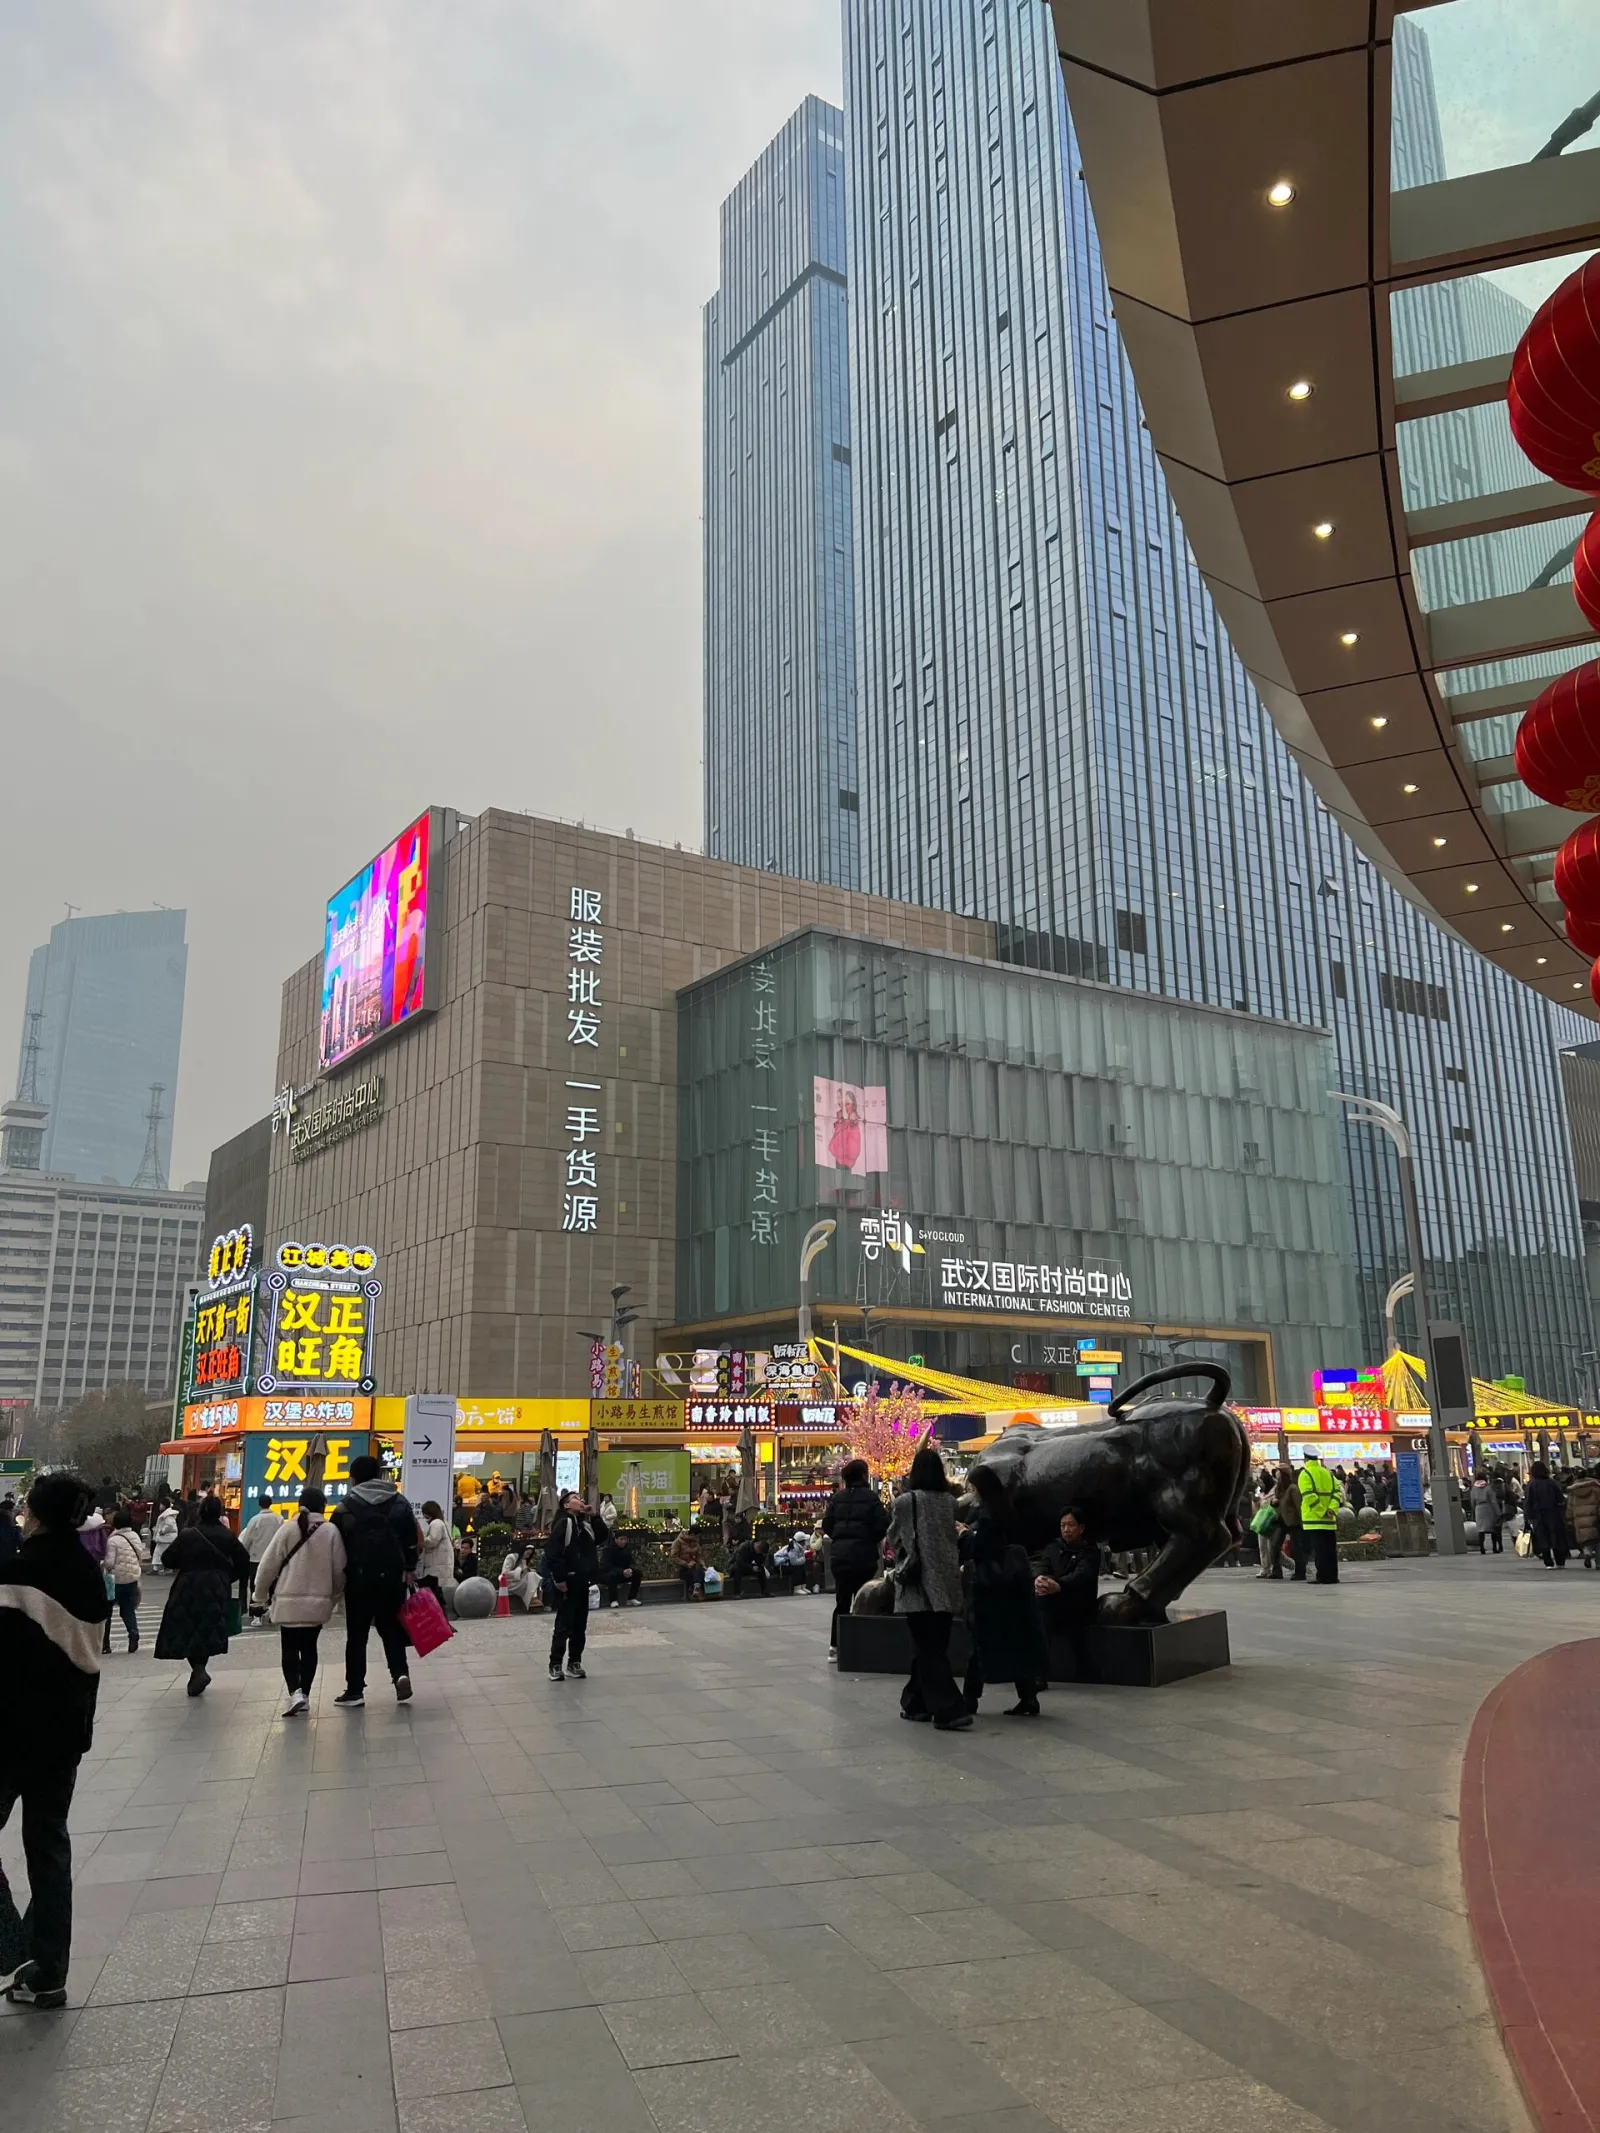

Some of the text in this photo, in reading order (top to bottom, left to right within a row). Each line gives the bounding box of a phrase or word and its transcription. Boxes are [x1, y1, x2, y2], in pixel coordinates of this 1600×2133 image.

[562, 886, 603, 1232] 服装批发 一手货源
[291, 1075, 380, 1150] 武汉国际时尚中心
[282, 1246, 374, 1268] 江城美味
[941, 1258, 1132, 1300] 武汉国际时尚中心
[195, 1296, 250, 1344] 天下第一街
[280, 1289, 364, 1335] 汉正
[944, 1291, 1131, 1317] INTERNATIONAL FASHION CENTER
[196, 1345, 240, 1385] 汉正旺角
[277, 1335, 363, 1380] 旺角
[589, 1341, 606, 1388] 小路易
[606, 1345, 620, 1397] 生煎馆
[765, 1364, 817, 1378] 深海鱼糕
[264, 1401, 354, 1420] 汉堡&炸鸡
[597, 1404, 678, 1420] 小路易生煎馆
[691, 1405, 770, 1423] 南香玲卤肉饭
